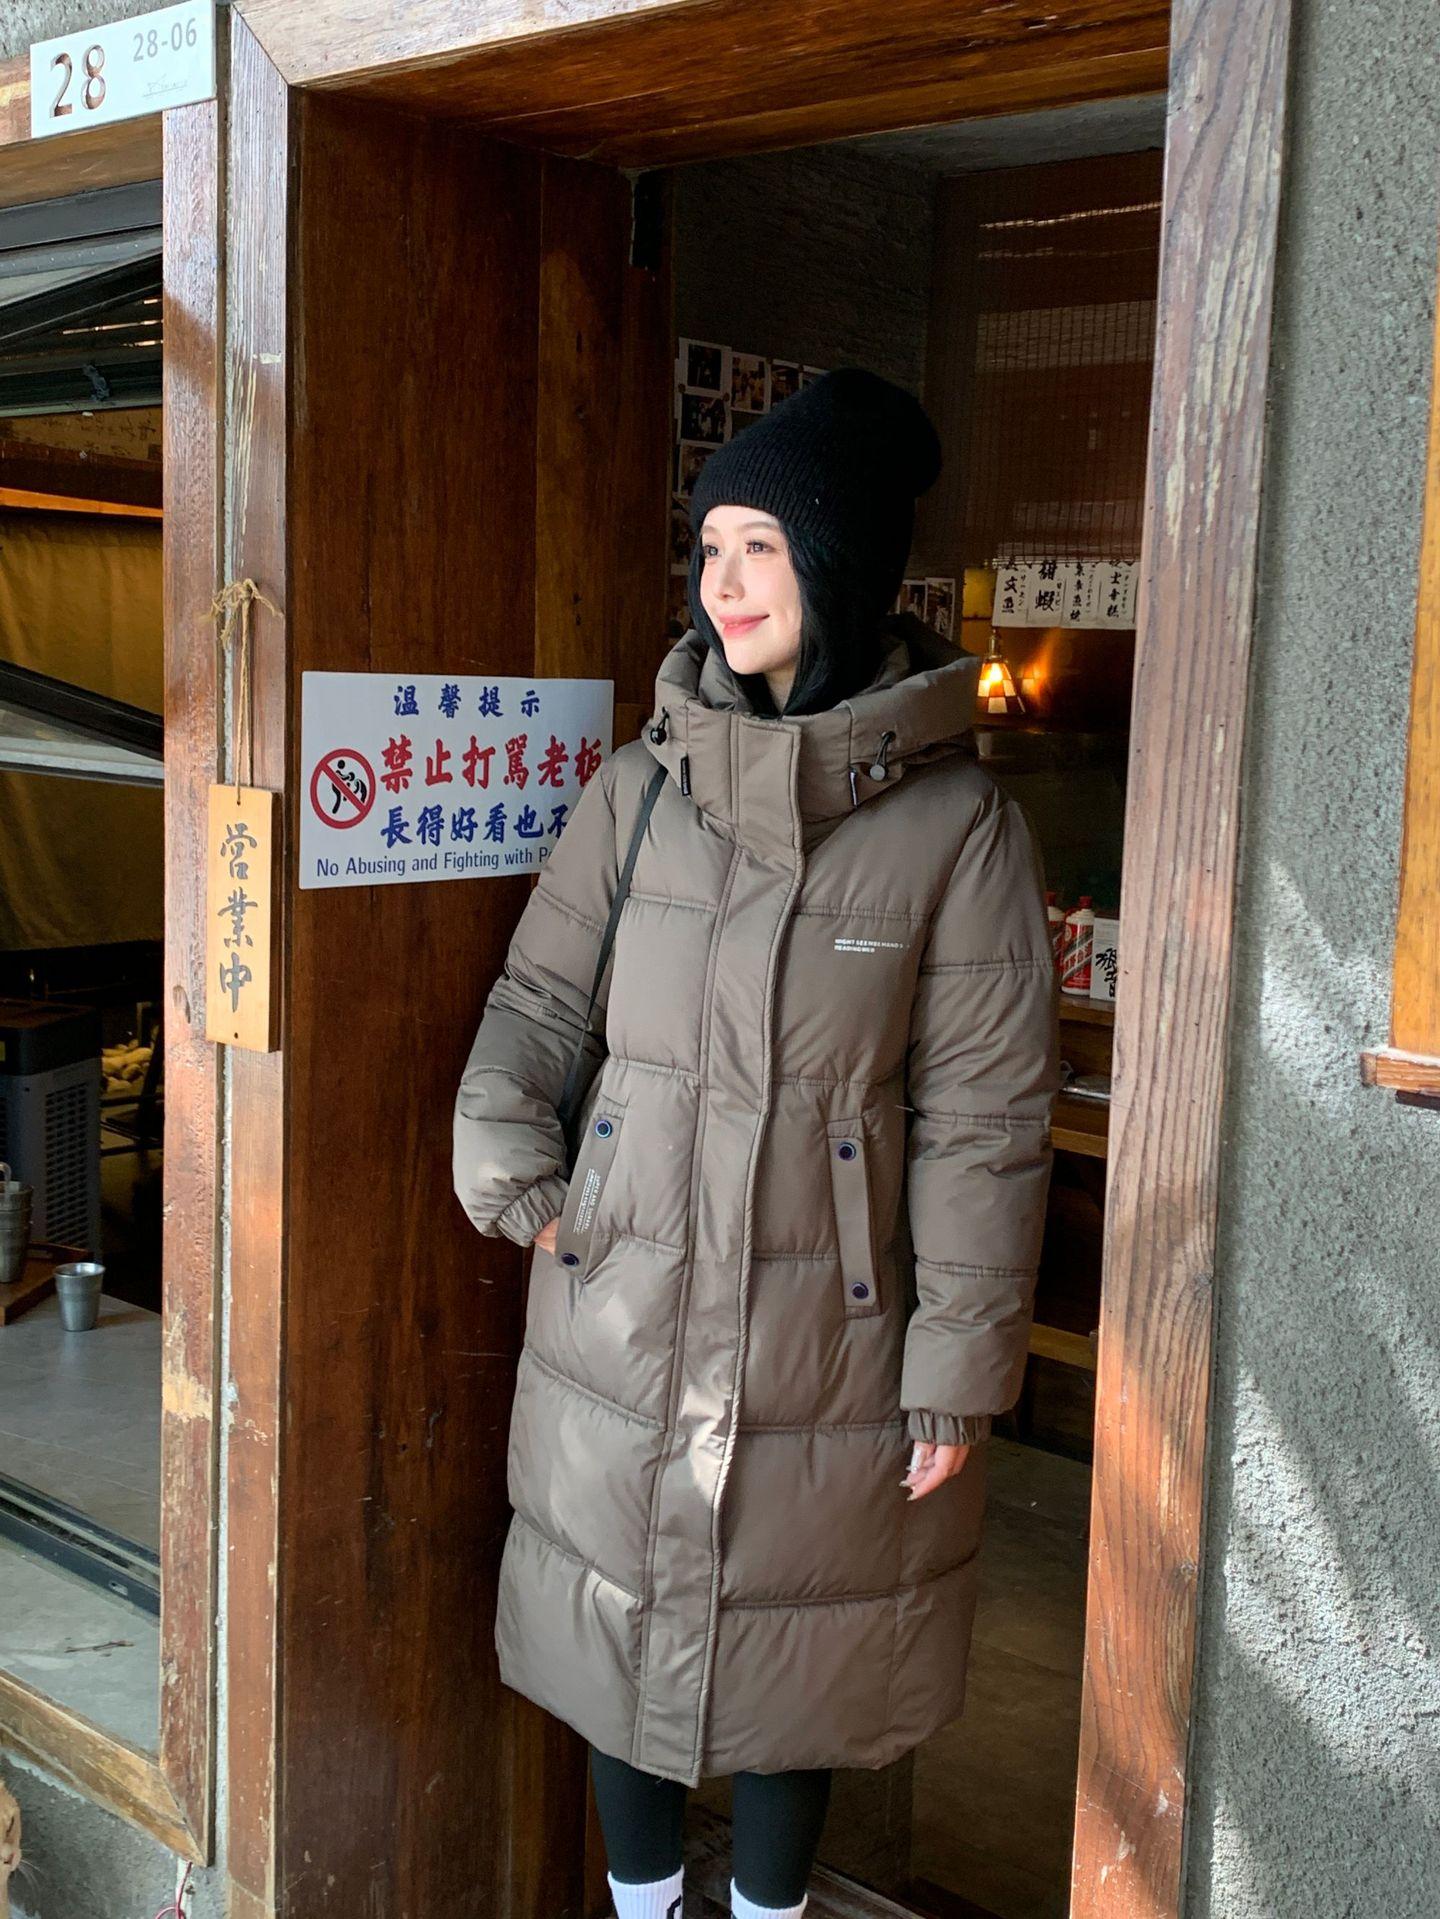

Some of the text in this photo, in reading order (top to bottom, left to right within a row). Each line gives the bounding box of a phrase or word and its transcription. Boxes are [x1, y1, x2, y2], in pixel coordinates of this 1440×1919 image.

[132, 18, 198, 63] 28-06
[49, 44, 107, 117] 28
[316, 858, 339, 877] No
[345, 855, 406, 876] Abusing
[411, 852, 438, 871] and
[443, 850, 499, 872] Fighting
[504, 848, 533, 868] with
